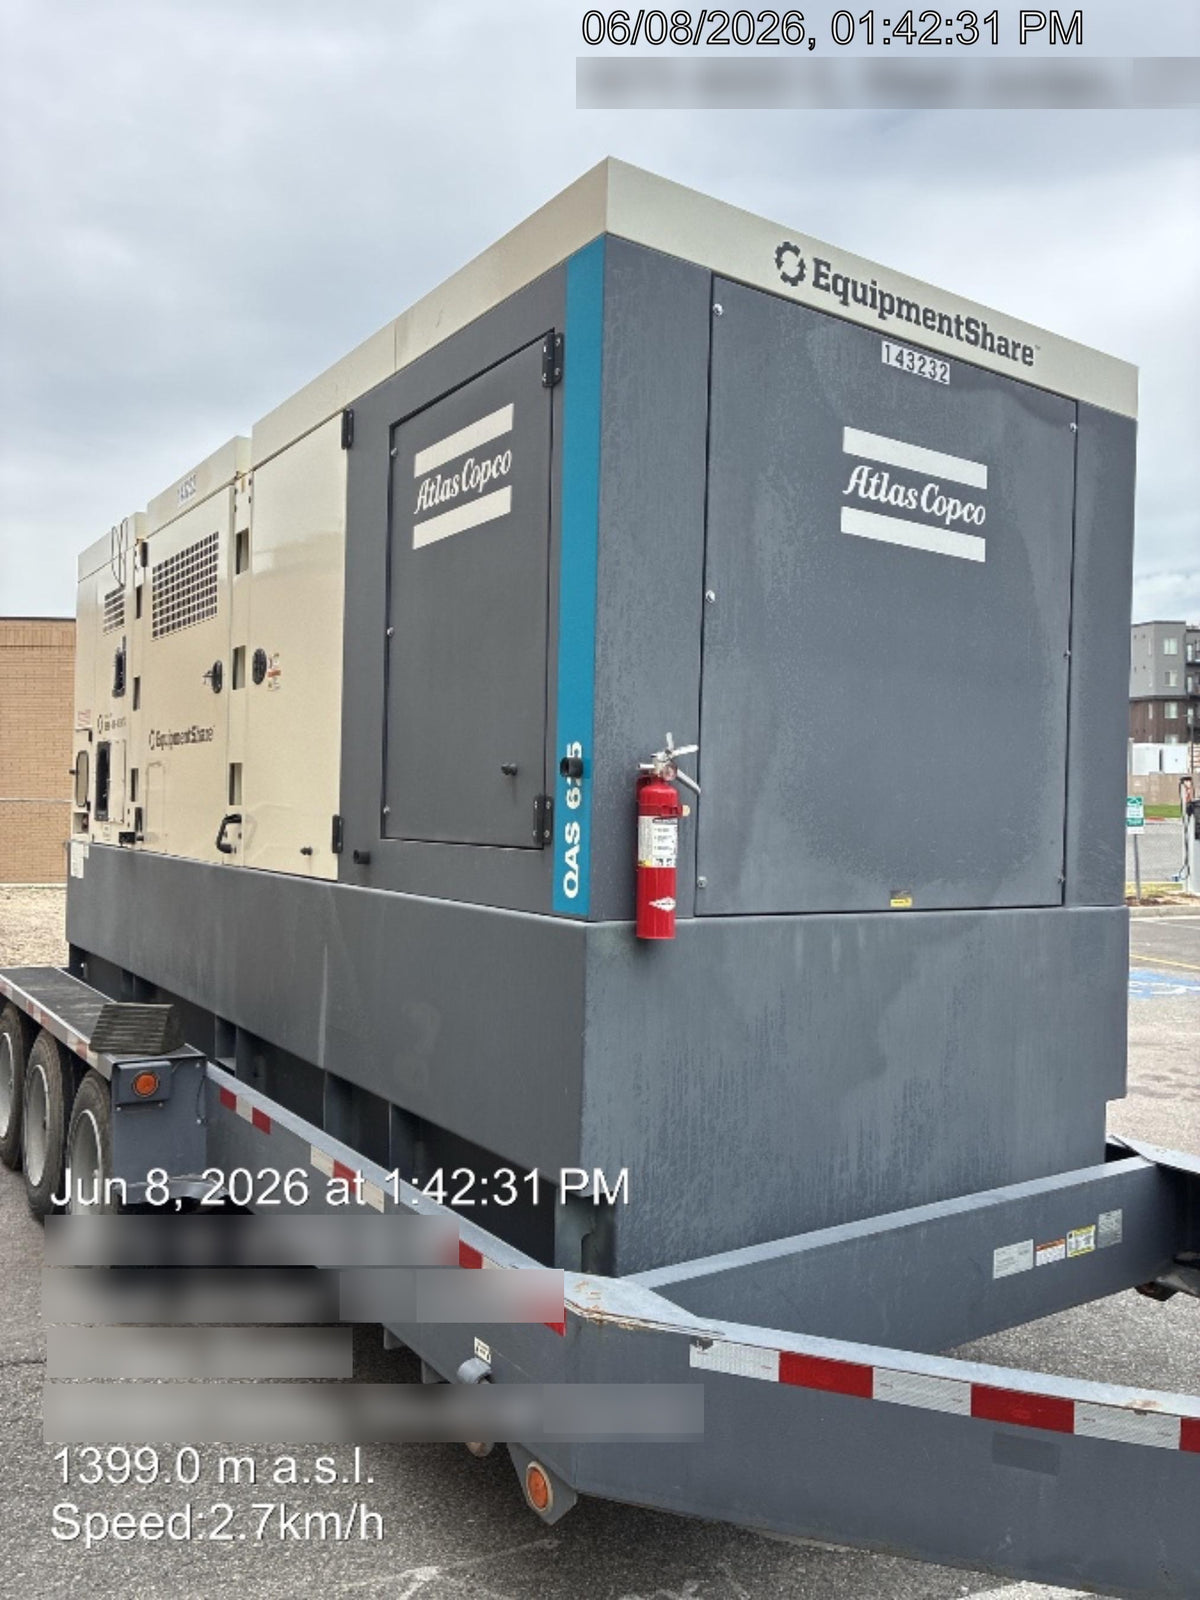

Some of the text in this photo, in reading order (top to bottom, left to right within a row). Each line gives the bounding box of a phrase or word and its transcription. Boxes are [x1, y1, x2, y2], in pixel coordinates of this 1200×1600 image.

[884, 342, 950, 383] 143232
[413, 448, 513, 515] Atlas Copco
[842, 464, 987, 526] Atlas Copco
[562, 820, 582, 899] QAS
